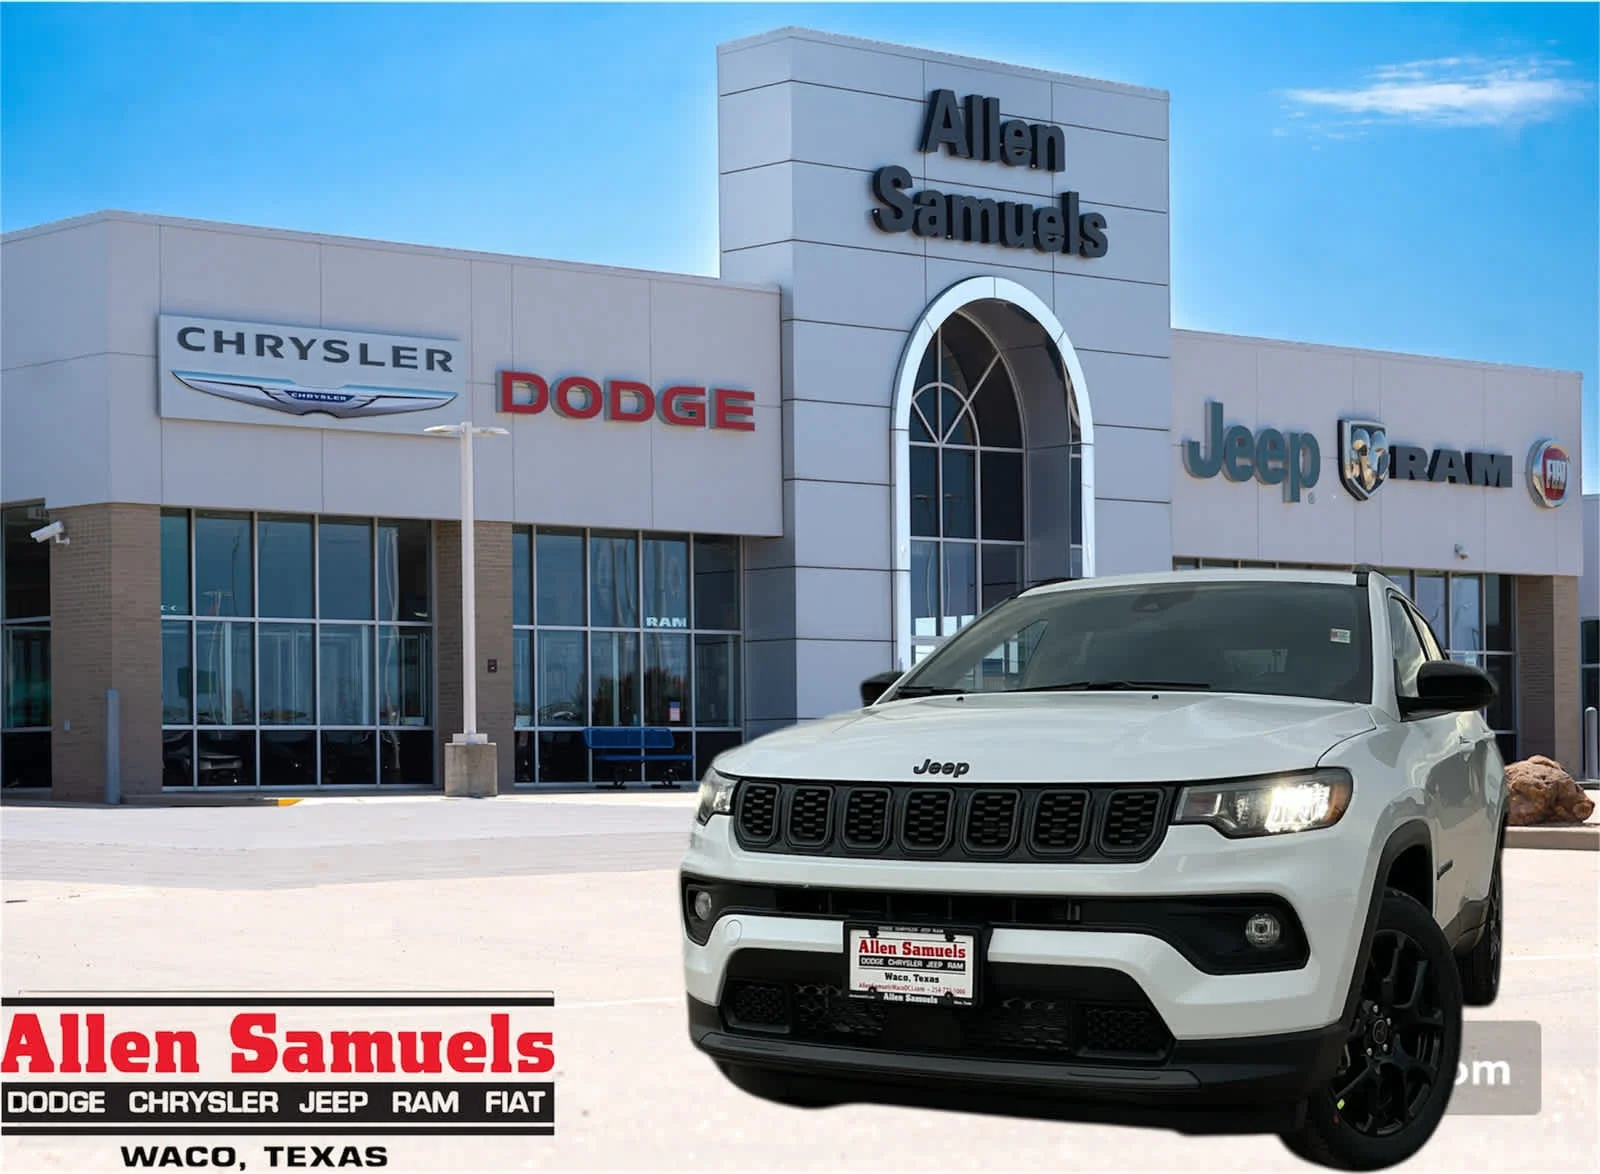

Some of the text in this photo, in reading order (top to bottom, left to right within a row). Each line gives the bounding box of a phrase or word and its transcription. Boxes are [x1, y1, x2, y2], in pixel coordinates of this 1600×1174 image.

[918, 89, 1066, 172] Allen
[872, 165, 1109, 258] Samuels
[177, 326, 453, 373] CHRYSLER
[291, 393, 346, 401] CHRYSLER
[496, 370, 755, 432] DODGE
[1182, 400, 1321, 503] Jeep
[1388, 444, 1513, 488] RAM
[646, 617, 687, 628] RAM
[913, 758, 970, 778] Jeep
[859, 939, 966, 959] Allen Samuels
[861, 957, 964, 970] DODGE CHRYSLER JEEP RAM
[884, 972, 940, 984] Waco, Texas
[883, 992, 904, 1002] Allen
[905, 994, 938, 1004] Samuels
